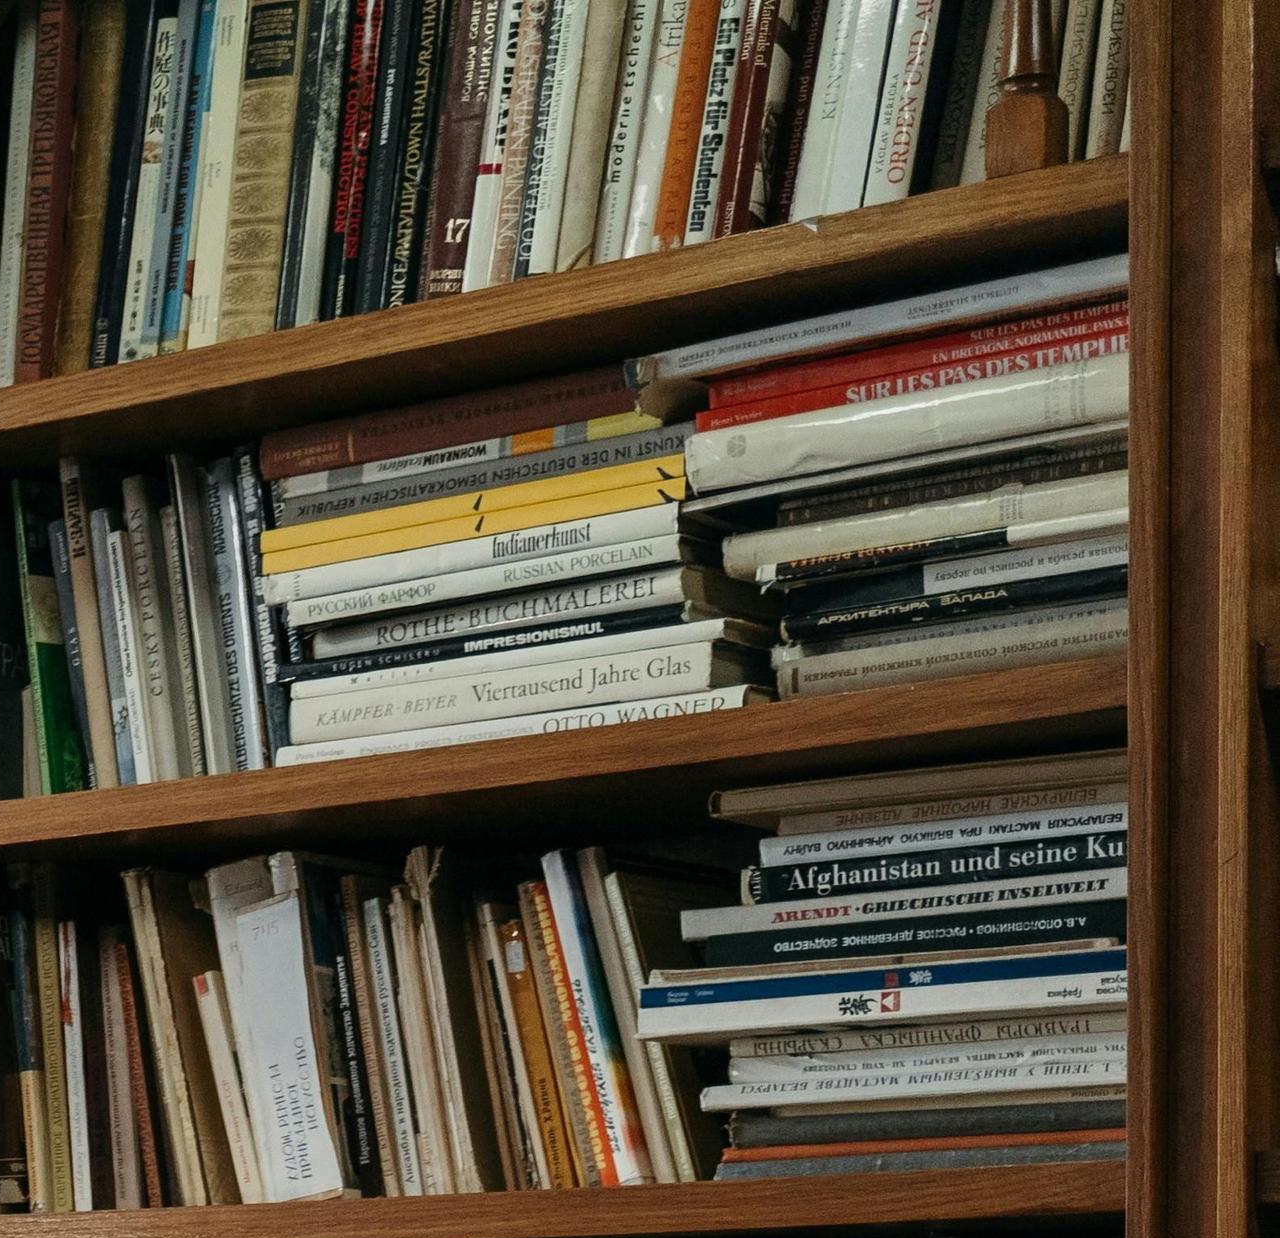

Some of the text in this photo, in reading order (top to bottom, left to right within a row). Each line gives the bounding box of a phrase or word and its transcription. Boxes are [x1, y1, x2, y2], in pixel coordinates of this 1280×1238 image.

[687, 17, 741, 233] Ein Platz für Studenten
[886, 30, 931, 185] ORDEN UND
[608, 95, 632, 184] moderne
[443, 217, 470, 244] 17
[844, 357, 1028, 406] SUR LES PAS DES
[295, 433, 685, 519] KUNST IN DER DEUTSCHEN DEMOKRATISCHEN REPUBLIK
[491, 522, 592, 560] Indianerkunst
[503, 542, 654, 584] RUSSIAN PORCELAIN
[306, 582, 437, 618] РУССКИЙ ФАРФОР
[376, 576, 658, 646] ROTHE BUCHMALEREI
[217, 592, 239, 675] DES ORIENTS
[464, 621, 605, 654] IMPRESIONISMUL
[471, 655, 692, 704] Viertausend Jahre Glas
[786, 842, 1078, 896] Afghanistan und seine
[770, 904, 853, 924] ARENDT
